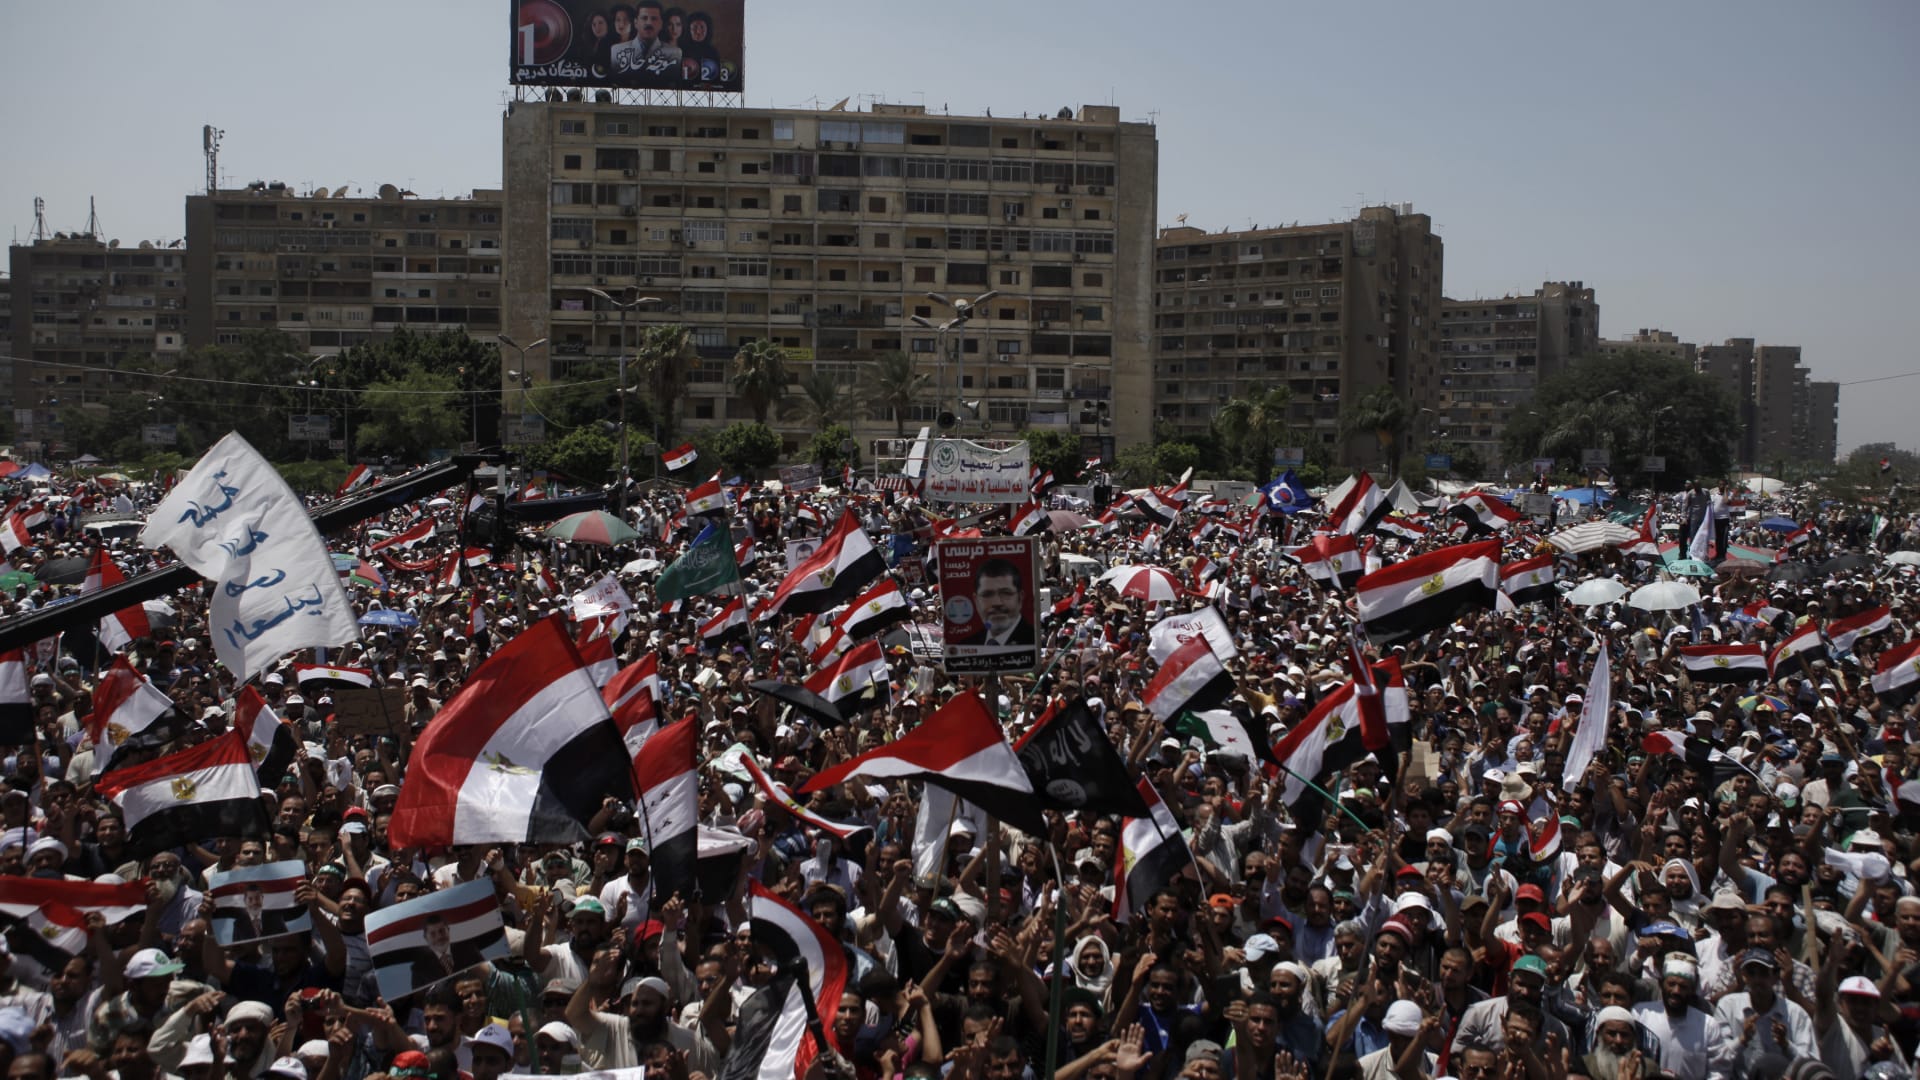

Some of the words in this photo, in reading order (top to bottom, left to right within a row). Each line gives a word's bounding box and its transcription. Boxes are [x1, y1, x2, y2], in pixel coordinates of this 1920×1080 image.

[549, 60, 588, 79] رمضان
[681, 67, 689, 80] 1
[700, 67, 710, 80] 2
[720, 68, 729, 81] 3
[997, 461, 1023, 473] مصر
[987, 543, 1025, 556] محمد
